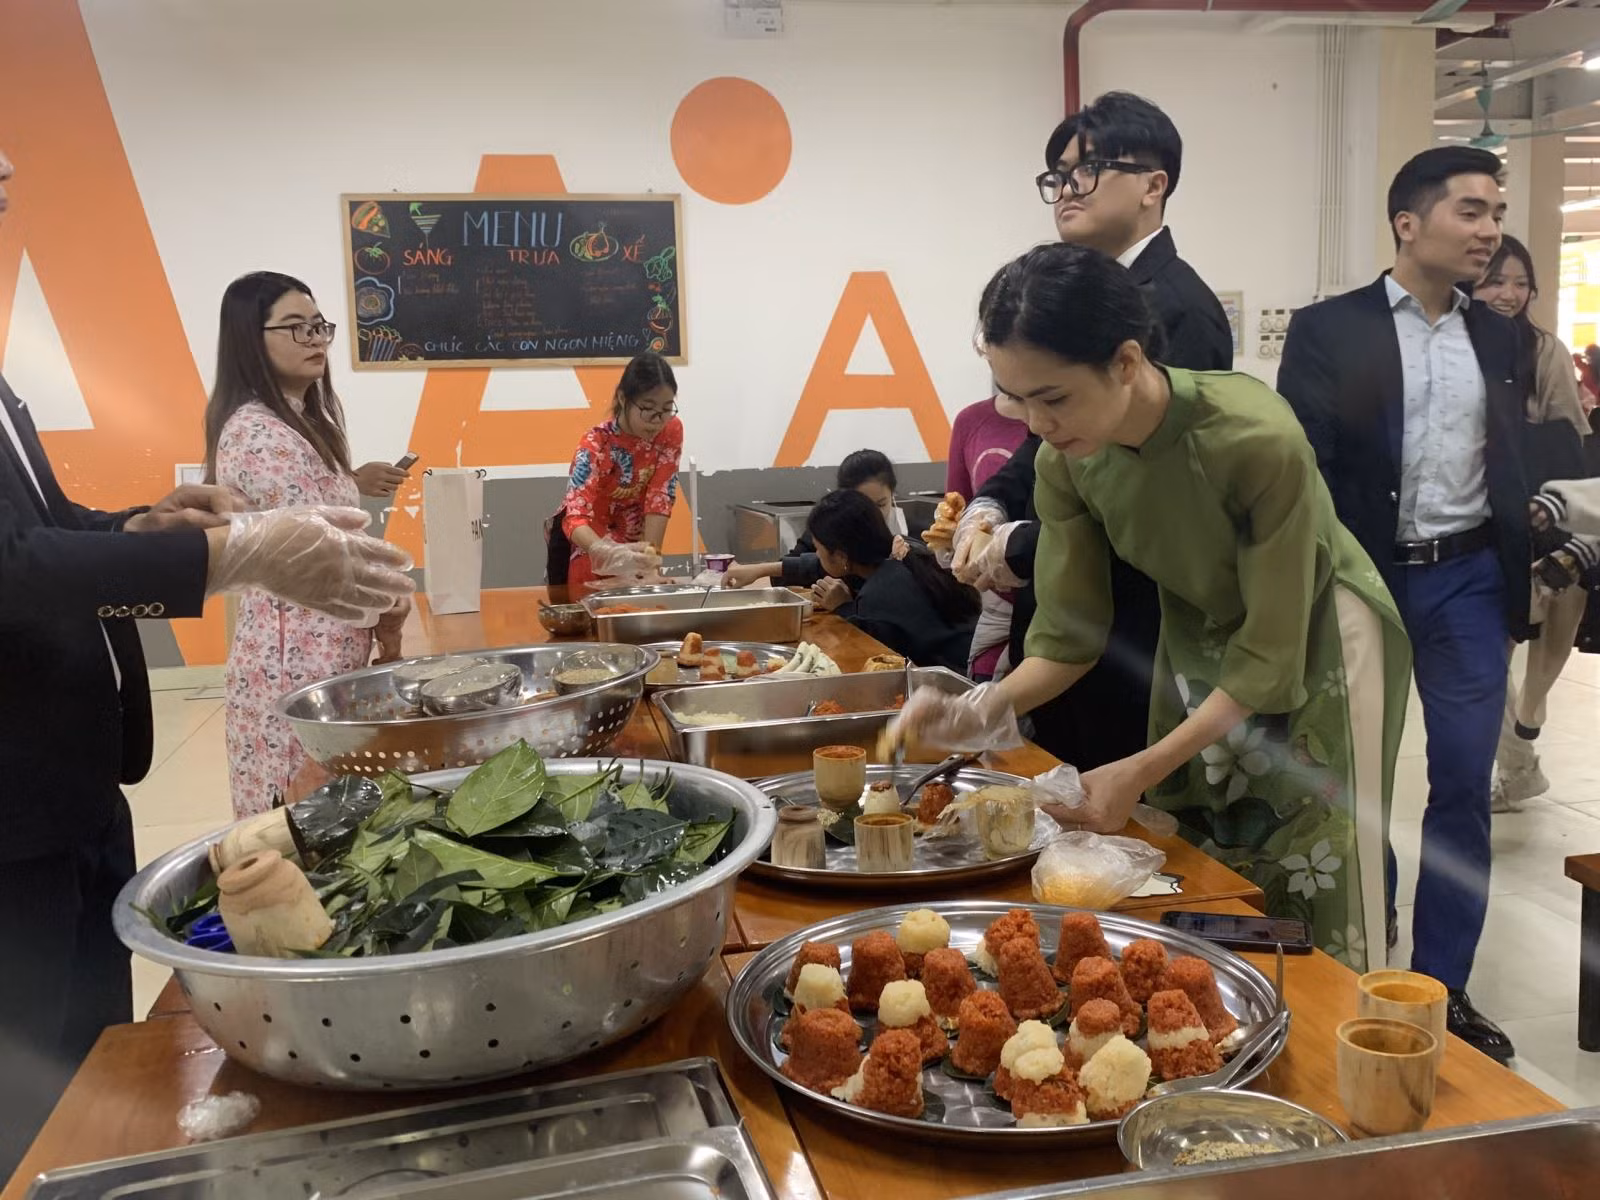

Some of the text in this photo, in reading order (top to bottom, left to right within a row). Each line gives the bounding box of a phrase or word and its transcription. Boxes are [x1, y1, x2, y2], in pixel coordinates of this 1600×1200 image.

[463, 210, 563, 247] MENU
[403, 241, 453, 266] SÁNG
[424, 335, 465, 353] CHÚC
[512, 340, 539, 352] CON
[545, 336, 588, 351] NGON
